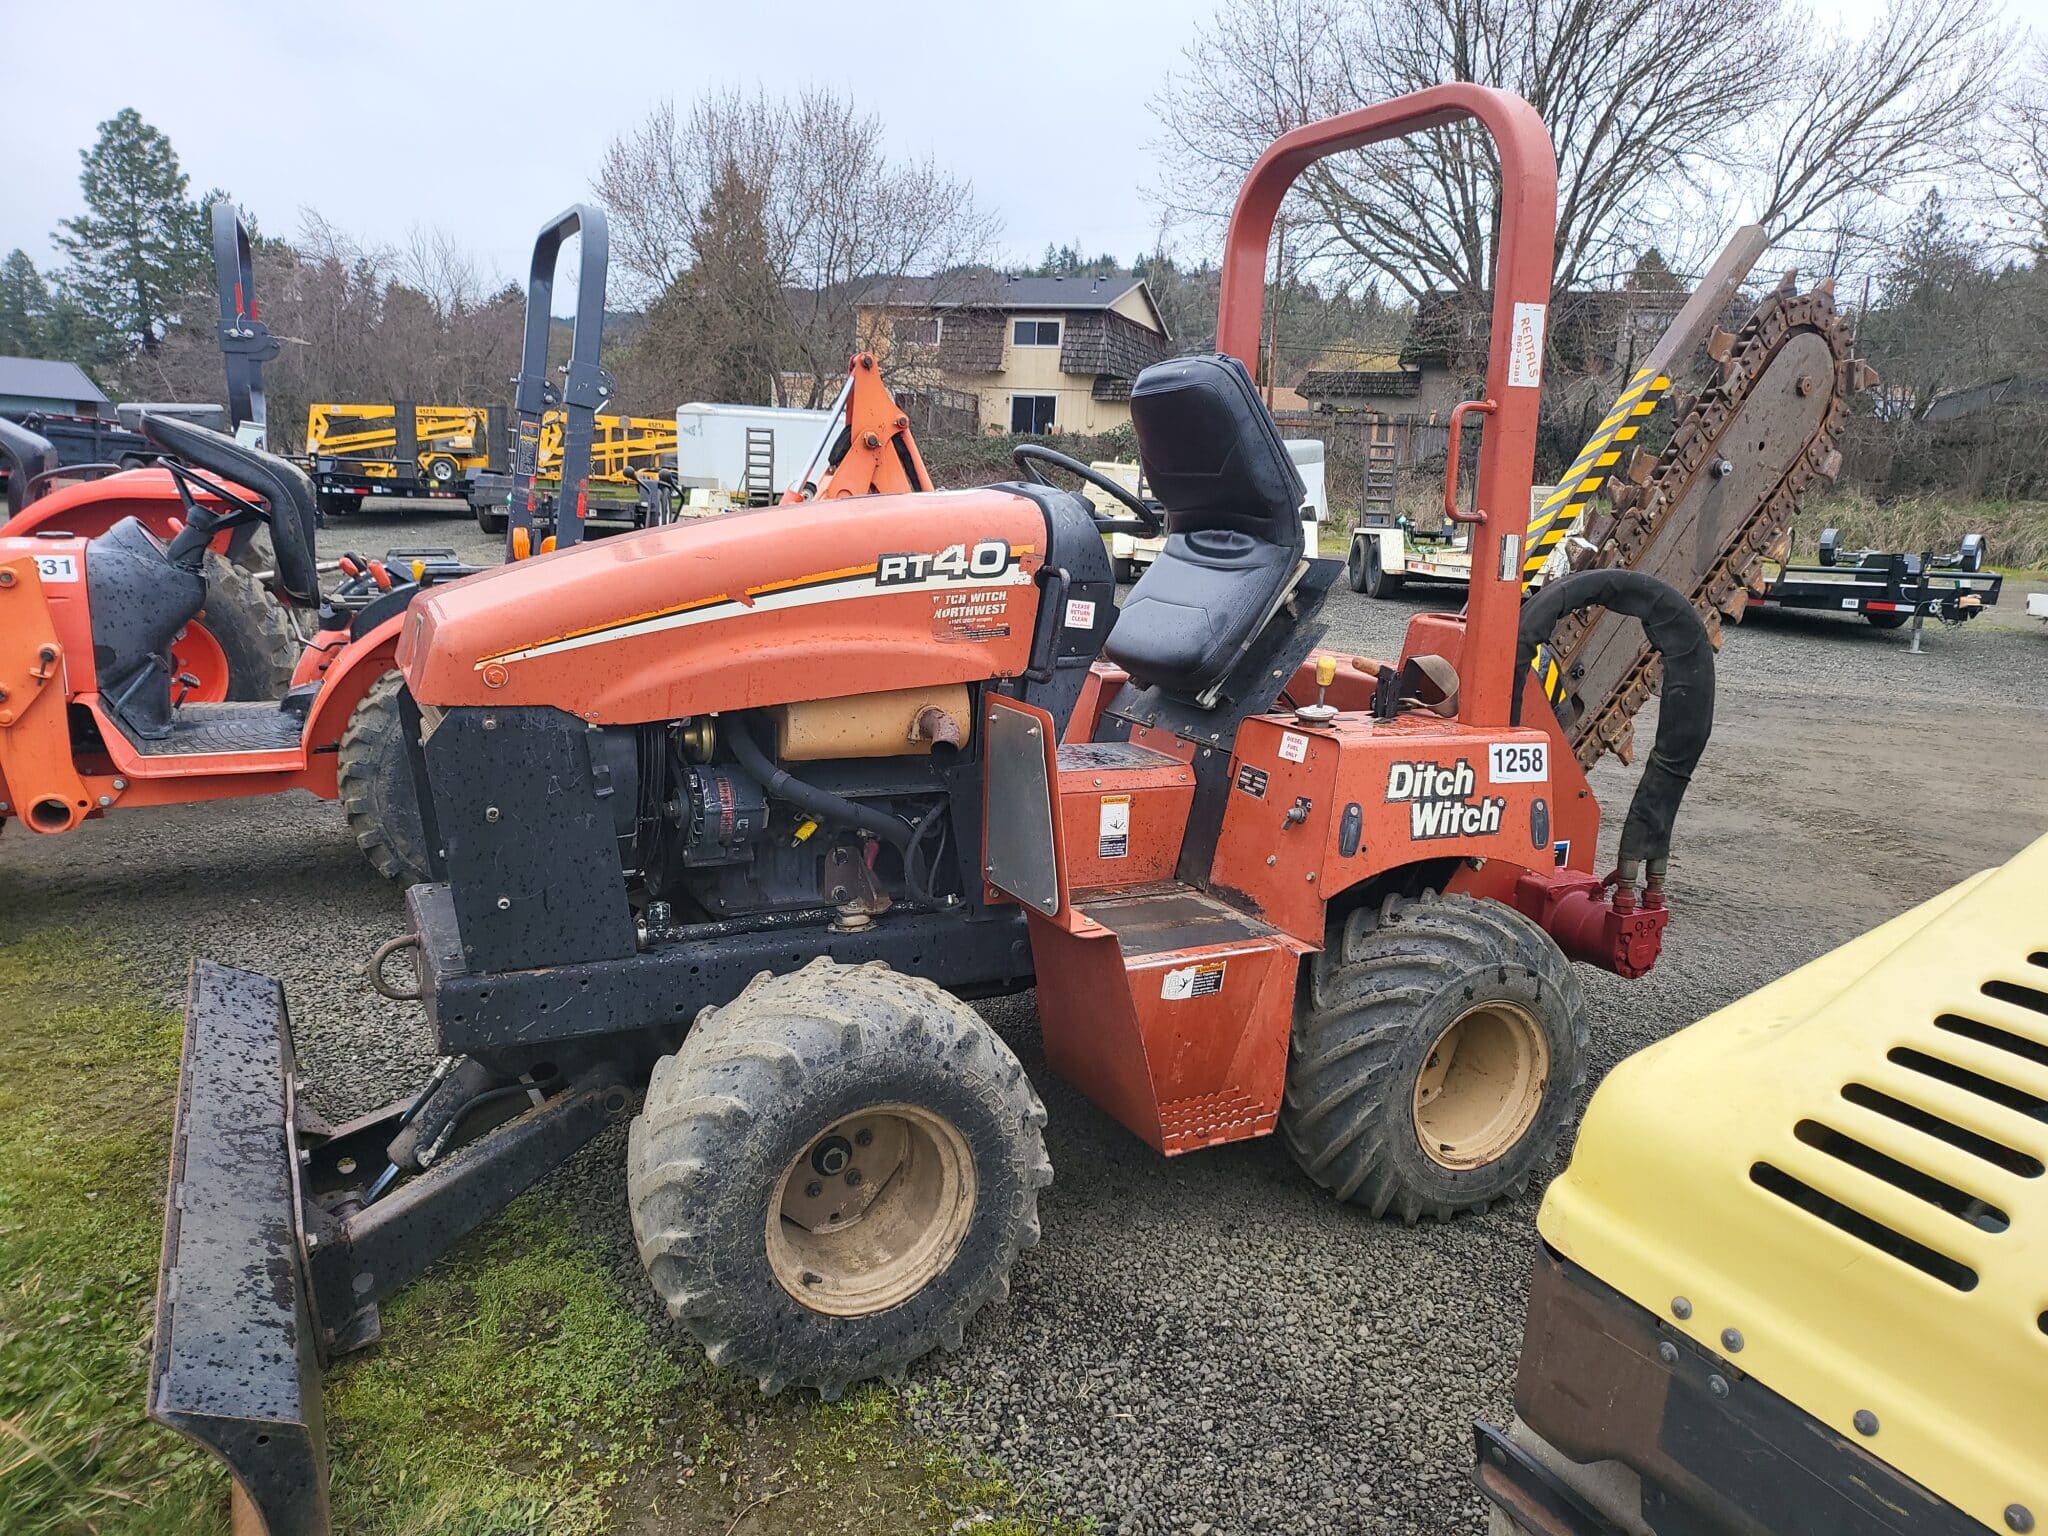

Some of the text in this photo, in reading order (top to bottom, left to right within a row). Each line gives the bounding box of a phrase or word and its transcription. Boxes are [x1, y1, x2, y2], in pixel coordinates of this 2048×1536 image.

[1521, 316, 1539, 378] RENTALS
[35, 559, 71, 576] 31
[880, 541, 1007, 582] RT40
[970, 591, 1007, 603] WITCH
[933, 604, 1007, 619] NORTHWEST
[1286, 735, 1303, 745] DIESEL
[1287, 743, 1299, 752] FUEL
[1285, 750, 1298, 759] ONLY
[1494, 748, 1543, 774] 1258
[1386, 760, 1475, 800] Ditch
[1411, 797, 1501, 838] Witch
